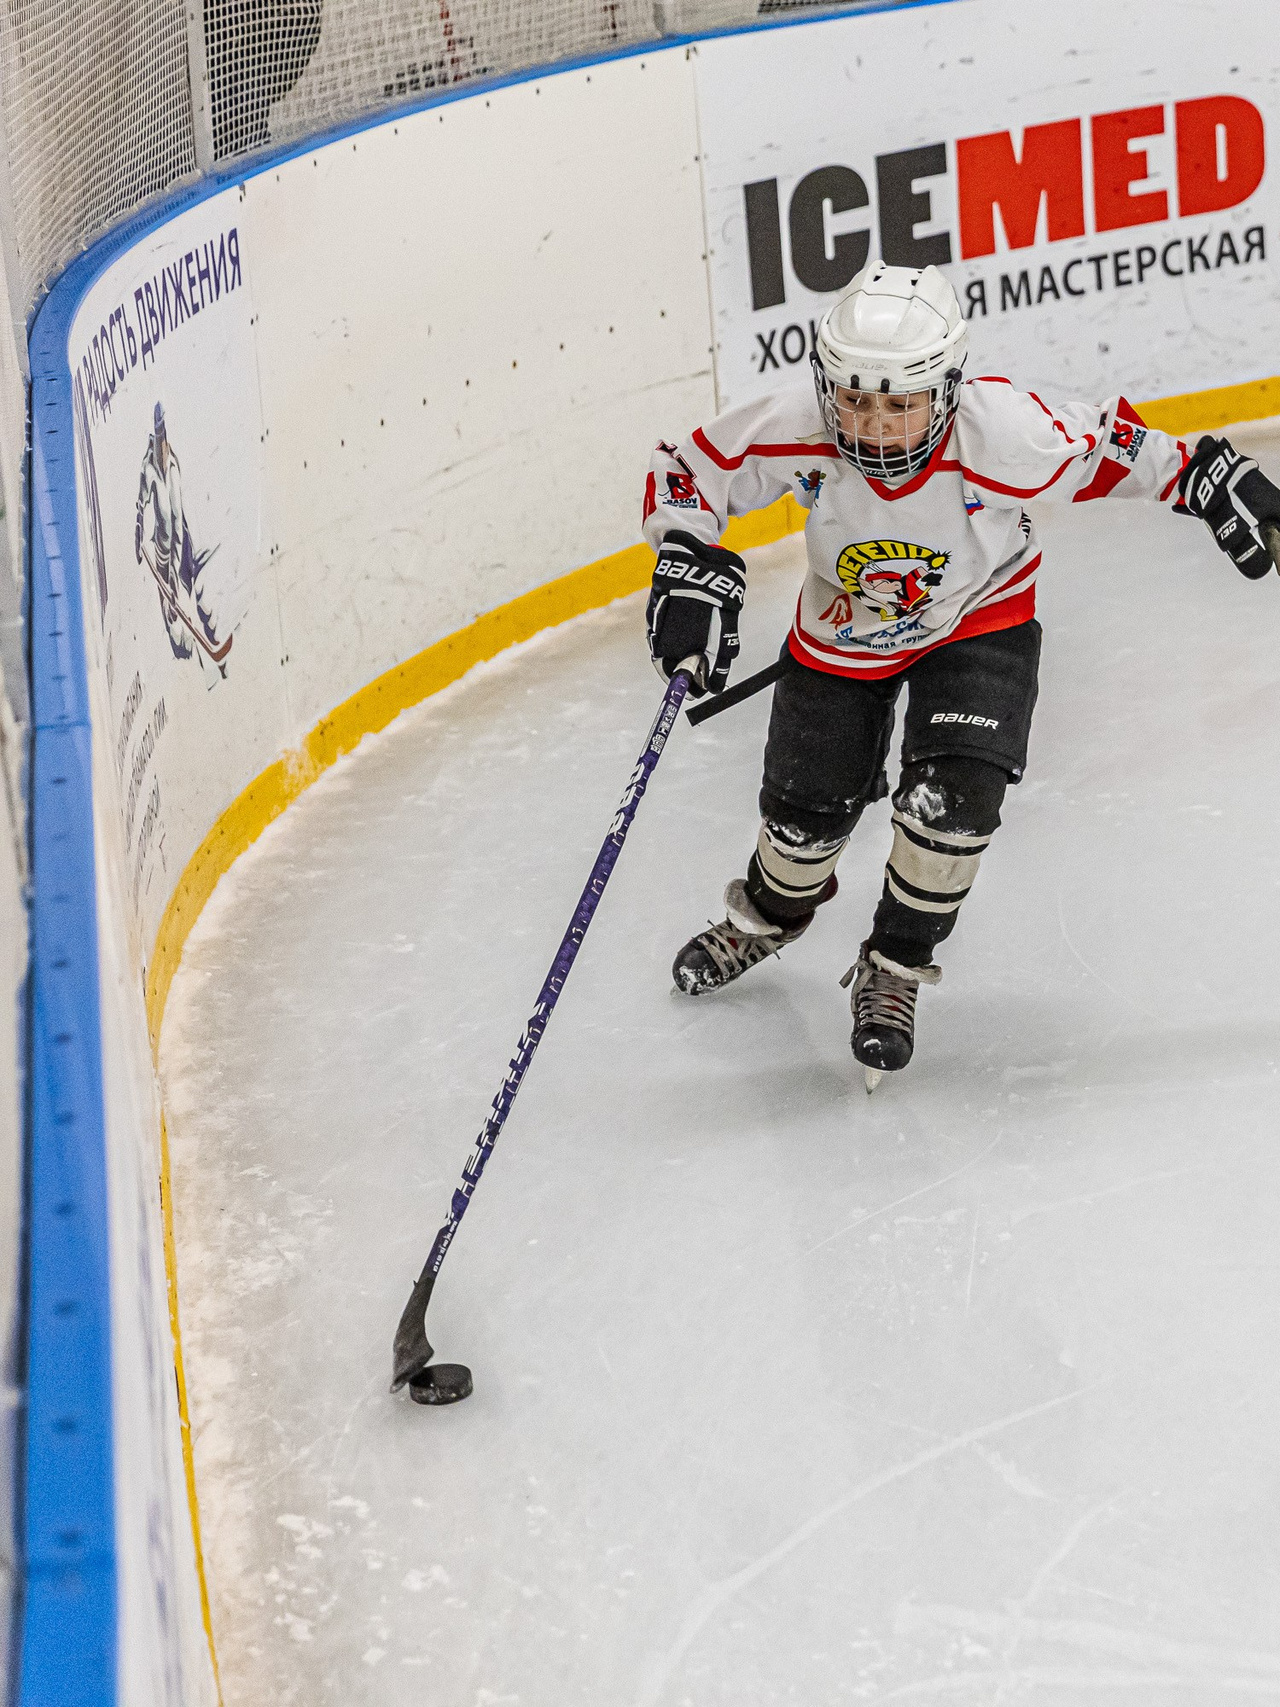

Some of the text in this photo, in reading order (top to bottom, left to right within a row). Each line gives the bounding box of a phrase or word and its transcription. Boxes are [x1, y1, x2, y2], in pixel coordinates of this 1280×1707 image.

[743, 94, 1265, 311] ICEMED
[1001, 225, 1267, 312] МАСТЕРСКАЯ
[83, 227, 242, 425] РАДОСТЬ ДВИЖЕНИЯ
[654, 559, 745, 605] BAUER
[930, 713, 999, 730] BAUER
